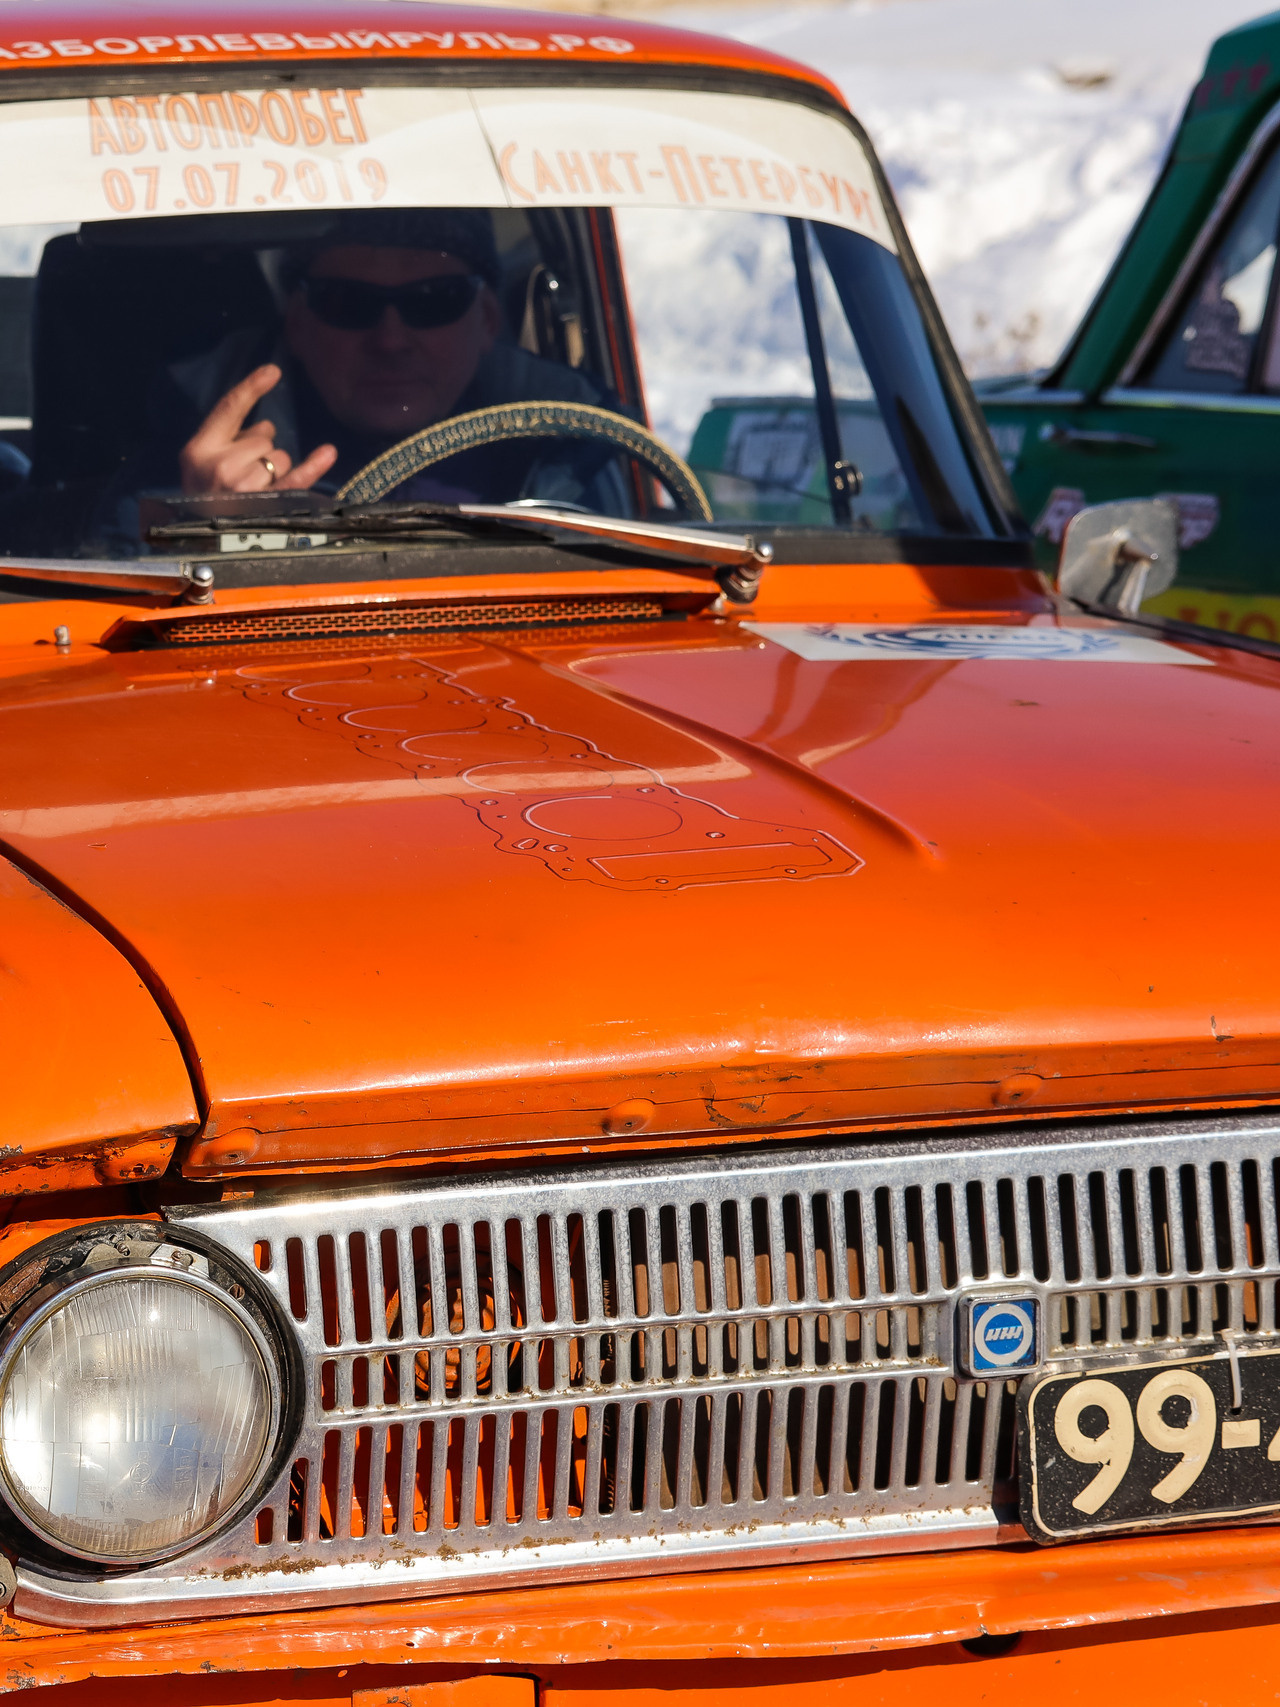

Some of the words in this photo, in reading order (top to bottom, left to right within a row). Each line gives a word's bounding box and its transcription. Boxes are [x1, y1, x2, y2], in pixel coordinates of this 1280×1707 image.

[88, 89, 369, 156] АВТОПРОБЕГ
[101, 157, 389, 213] 07.07.2019
[1054, 1369, 1280, 1516] 99-
